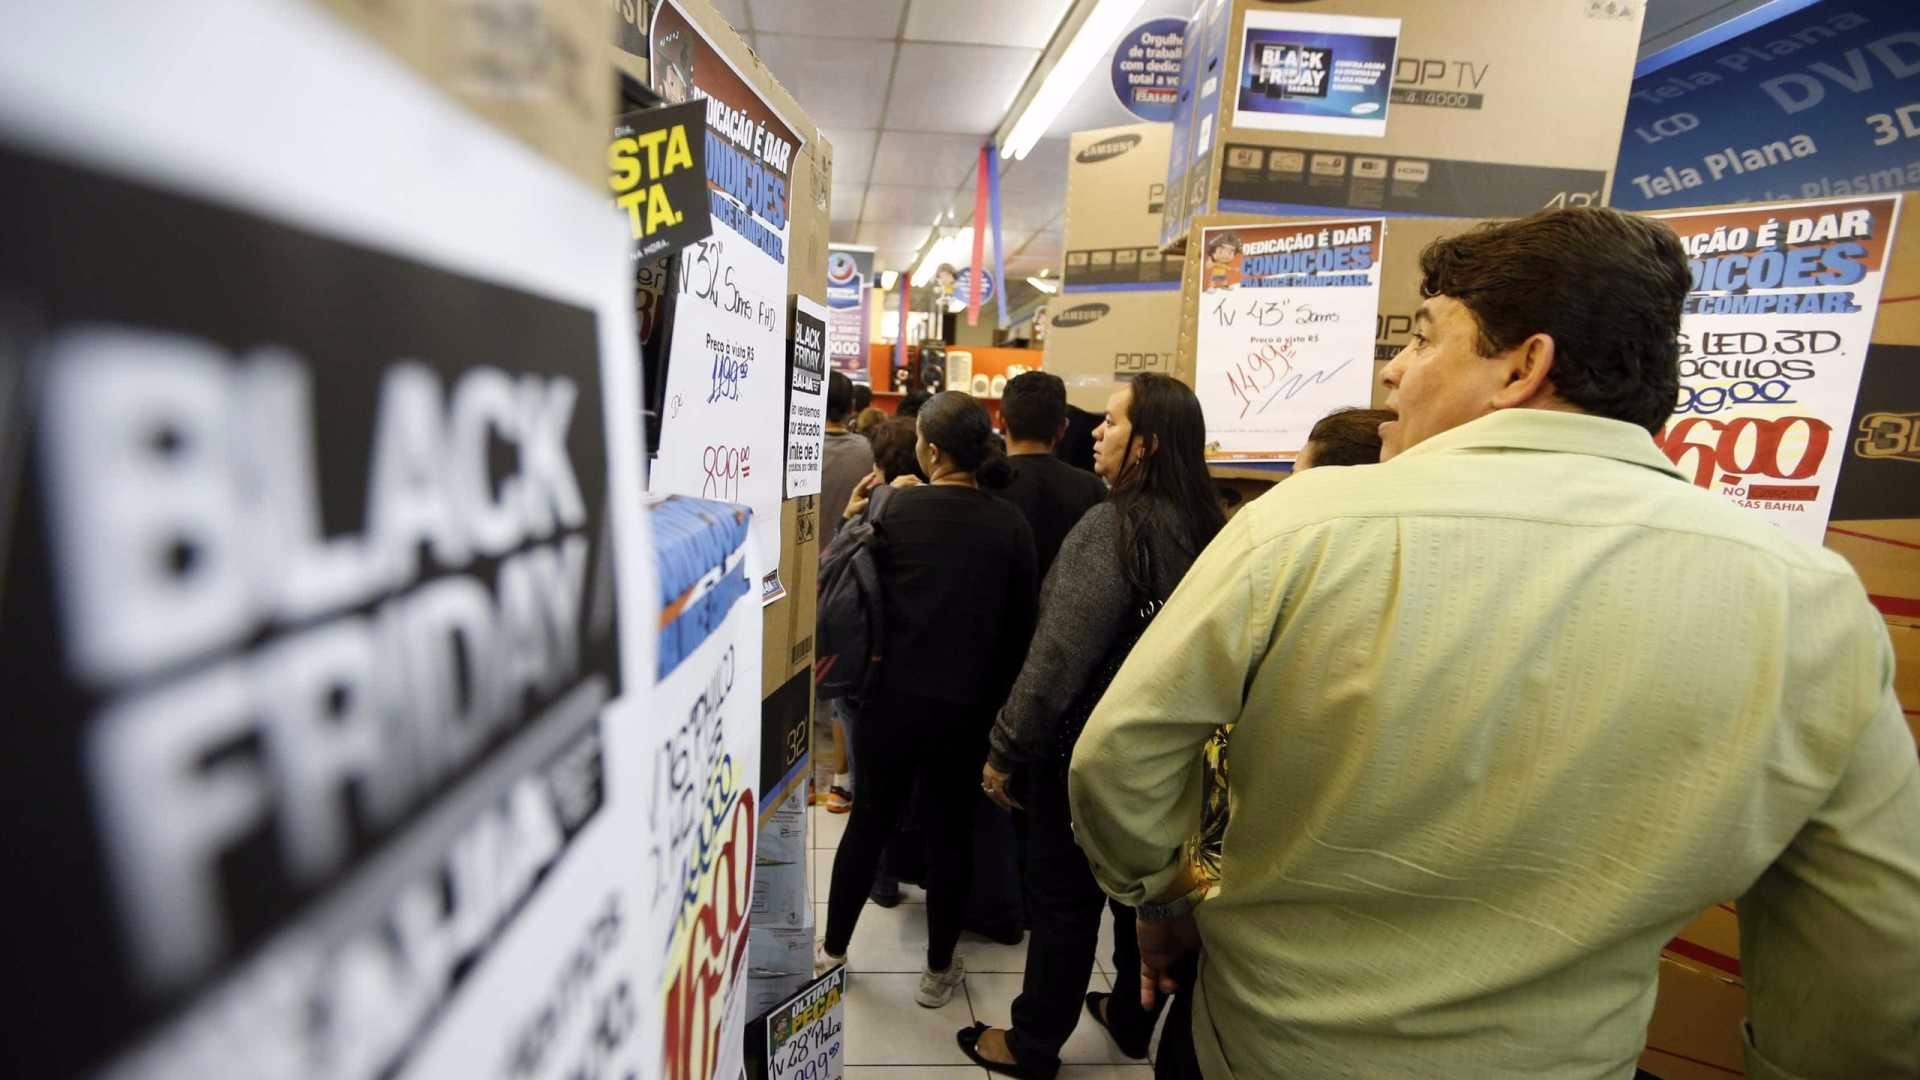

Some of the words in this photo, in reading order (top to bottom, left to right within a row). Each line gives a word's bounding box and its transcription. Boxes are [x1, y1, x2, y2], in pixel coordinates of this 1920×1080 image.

[1129, 46, 1144, 57] de
[1716, 12, 1869, 73] Plana
[1120, 61, 1144, 71] com
[1261, 49, 1324, 70] BLACK
[1760, 31, 1920, 115] DVD
[1129, 73, 1154, 85] total
[1157, 75, 1164, 85] a
[1259, 67, 1326, 87] FRIDAY
[1453, 61, 1489, 88] TV
[1635, 112, 1700, 144] LCD
[751, 120, 766, 157] É
[763, 133, 791, 174] DAR
[1632, 166, 1703, 199] Tela
[1704, 134, 1818, 180] Plana
[1242, 232, 1314, 257] DEDICAÇÃO
[1318, 228, 1330, 247] É
[1333, 225, 1373, 246] DAR
[1756, 219, 1779, 248] É
[1785, 209, 1873, 245] DAR
[1241, 246, 1373, 276] CONDIÇÕES
[758, 301, 776, 333] FHD
[1246, 298, 1291, 327] 43"
[1700, 291, 1863, 316] COMPRAR.
[706, 333, 725, 353] Preço
[796, 321, 820, 350] BLACK
[794, 346, 819, 371] FRIDAY
[797, 421, 821, 437] atacado
[804, 443, 812, 462] de
[813, 442, 819, 462] 3
[45, 330, 586, 675] BLACK
[1723, 486, 1746, 497] NO
[1764, 501, 1805, 513] BAHIA
[786, 720, 806, 766] 32
[88, 532, 588, 985] FRIDAY
